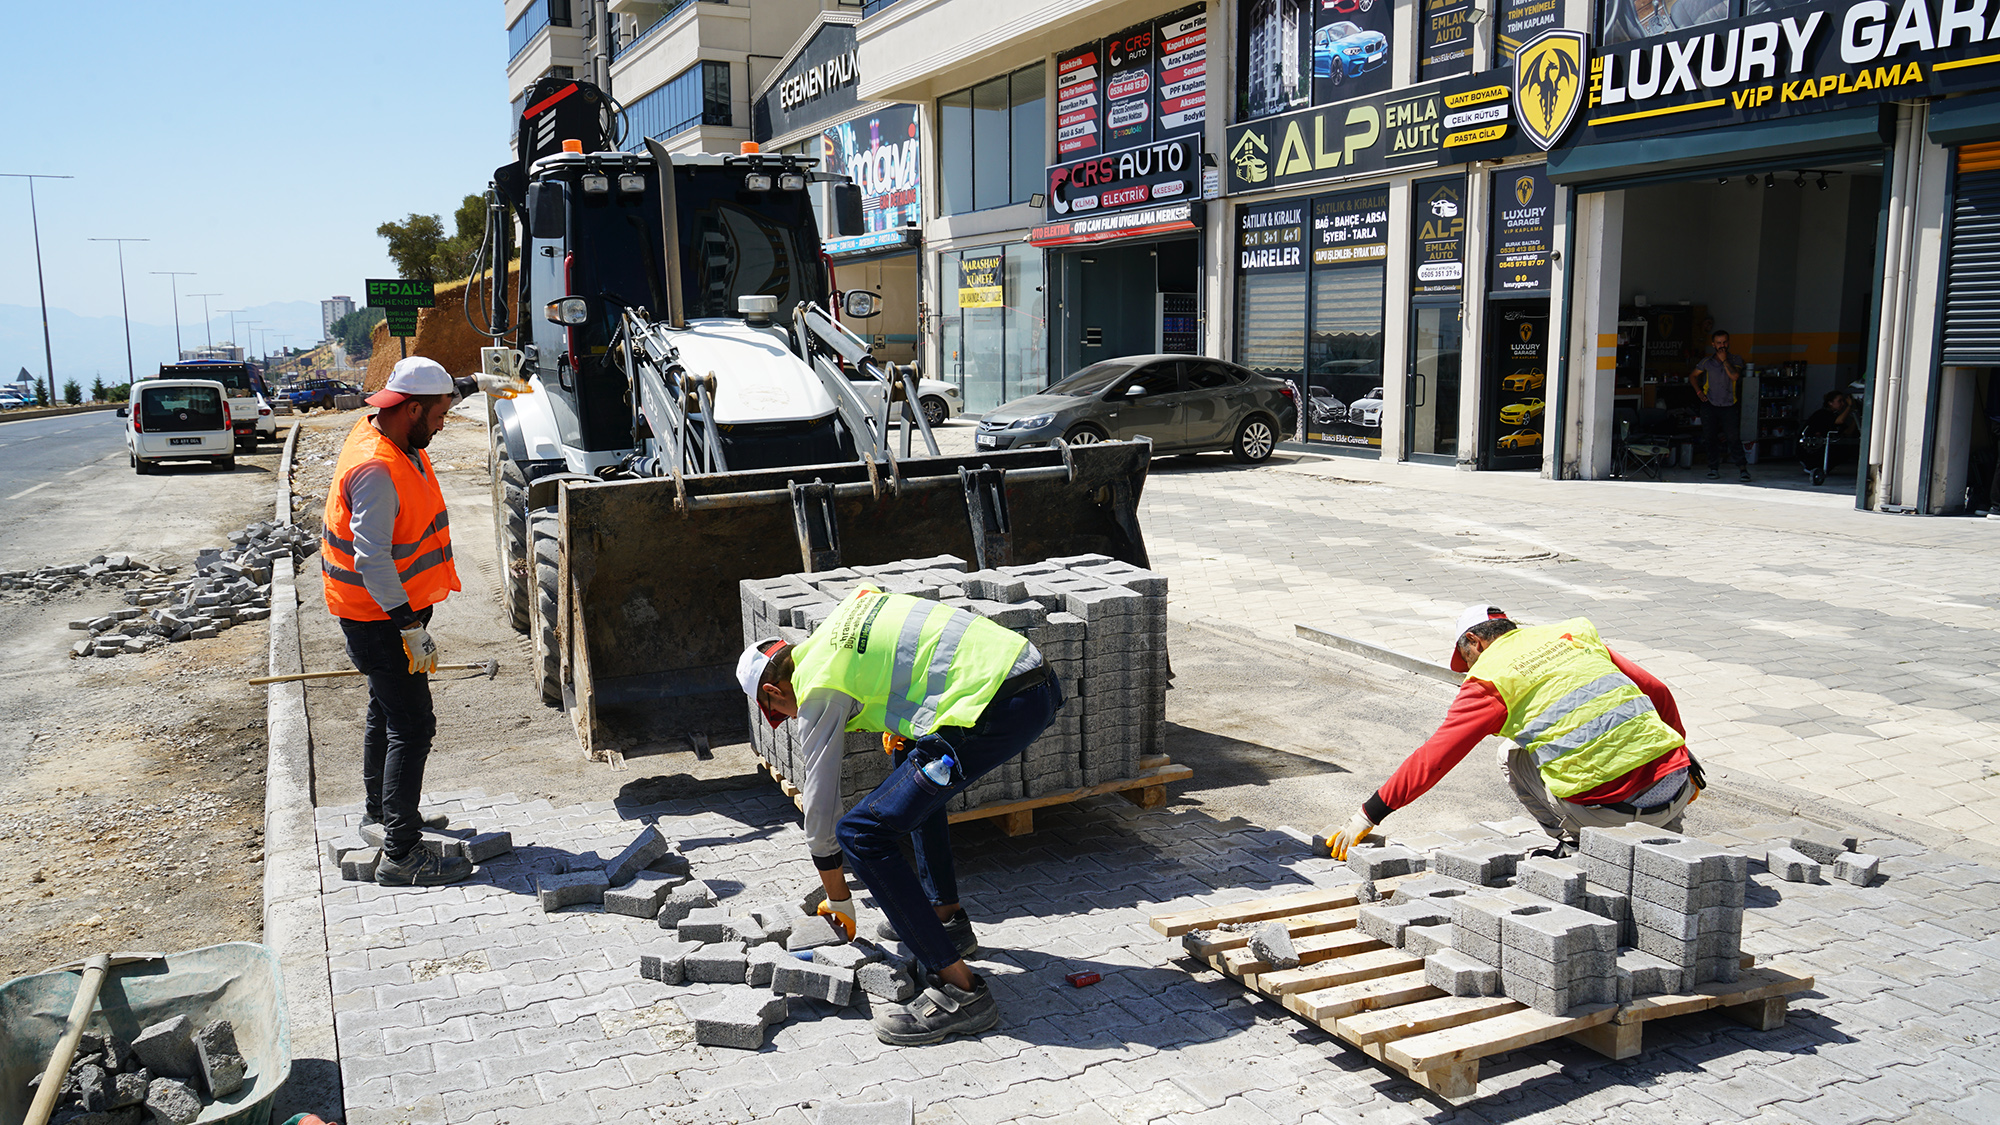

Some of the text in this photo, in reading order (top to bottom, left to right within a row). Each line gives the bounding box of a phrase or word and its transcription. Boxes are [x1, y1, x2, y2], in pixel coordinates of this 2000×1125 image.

[1180, 22, 1193, 31] Cam
[1432, 10, 1466, 30] EMLAK
[1508, 13, 1555, 33] TRİM KAPLAMA
[1125, 32, 1151, 52] CRS
[1436, 26, 1462, 43] AUTO
[1167, 39, 1184, 51] Kaput
[1601, 0, 2000, 105] LUXURY GAR
[1129, 49, 1147, 60] AUTO
[1168, 56, 1181, 66] Araç
[1060, 58, 1083, 71] Elektrik
[780, 63, 825, 109] EGEMEN
[1060, 75, 1077, 85] Klima
[1588, 56, 1604, 108] THE
[1781, 61, 1923, 102] KAPLAMA
[1170, 85, 1181, 95] PPF
[1450, 88, 1503, 105] JANT BOYAMA
[1079, 98, 1088, 106] Park
[1060, 113, 1085, 126] Led Xenon
[1386, 98, 1439, 129] EMLA
[1452, 113, 1473, 125] ÇELİK
[1275, 105, 1380, 177] ALP
[1454, 129, 1496, 143] PASTA CİLA
[848, 123, 916, 196] mavi
[1071, 142, 1184, 188] CRS AUTO
[1103, 186, 1145, 206] ELEKTRİK
[1154, 183, 1183, 195] AKSESUAR
[1074, 198, 1096, 208] KLİMA
[1316, 200, 1345, 215] SATILIK
[1346, 200, 1352, 211] &
[1242, 213, 1267, 229] SATILIK
[1268, 212, 1273, 226] &
[1315, 211, 1387, 230] BAĞ BAHÇE ARSA
[1503, 207, 1546, 220] LUXURY
[1032, 228, 1044, 239] OTO
[1074, 221, 1087, 234] OTO
[1087, 219, 1101, 232] CAM
[1119, 211, 1155, 228] UYGULAMA
[1419, 218, 1464, 239] ALP
[1507, 218, 1540, 227] GARAGE
[1245, 228, 1298, 245] 2+1 3+1 4+1
[1323, 227, 1377, 245] İŞYERİ TARLA
[1353, 246, 1369, 258] EVRAK
[1425, 242, 1457, 252] EMLAK
[1429, 251, 1453, 260] AUTO
[962, 257, 999, 273] MARAŞHAN
[967, 273, 994, 288] KÜNEFE
[369, 283, 422, 295] EFDAL
[371, 297, 433, 306] MÜHENDİSLİK
[1647, 341, 1683, 350] LUXURY
[1336, 434, 1347, 442] Elde
[1347, 435, 1369, 444] Güvenle
